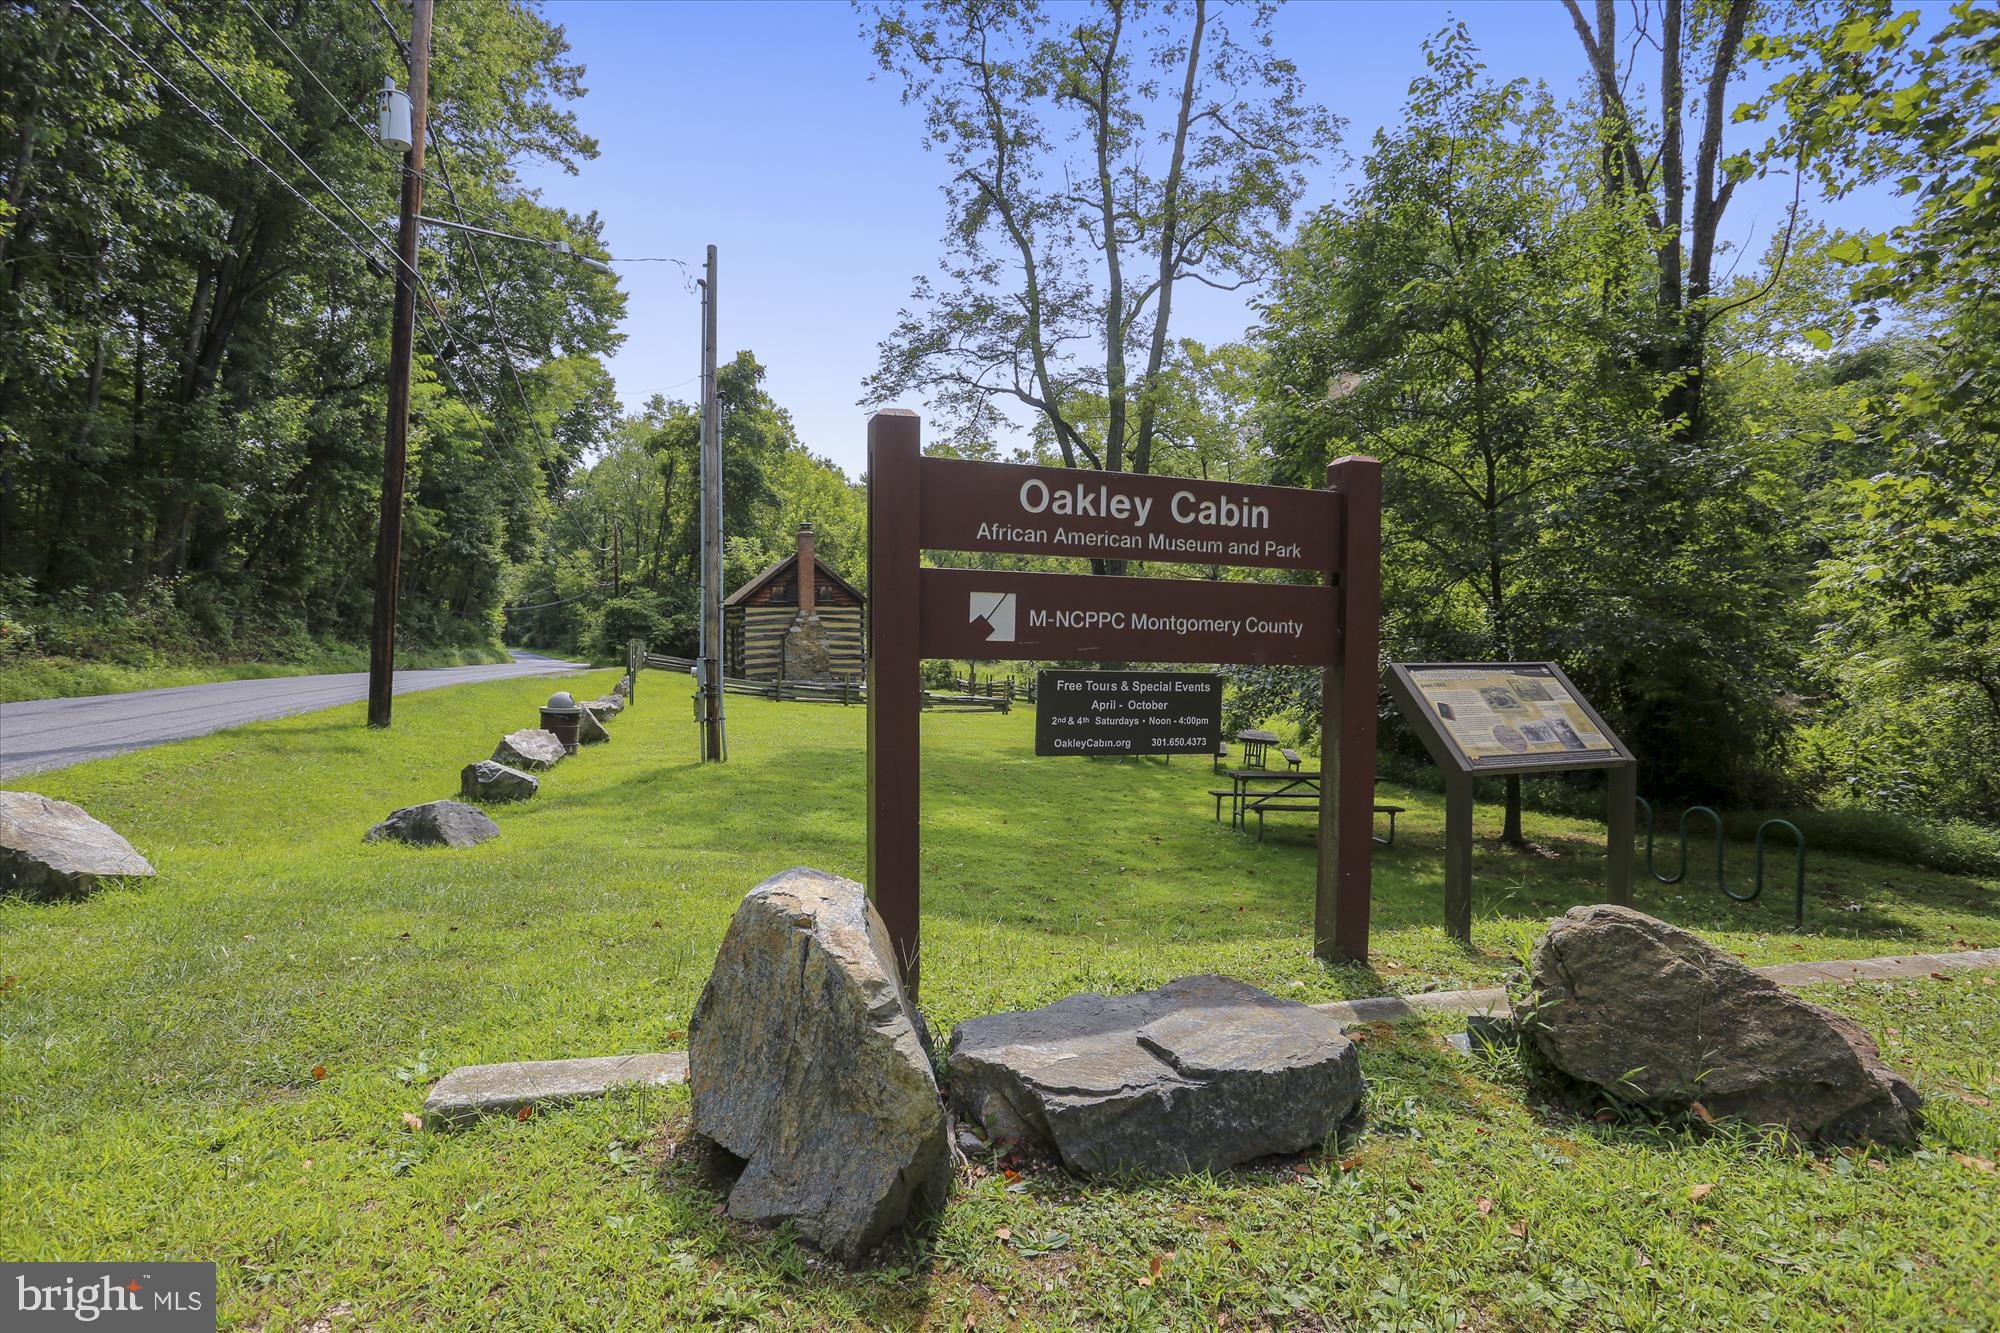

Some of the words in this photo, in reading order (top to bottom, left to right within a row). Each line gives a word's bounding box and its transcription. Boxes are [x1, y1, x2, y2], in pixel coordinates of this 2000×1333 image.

[1020, 479, 1153, 527] Oakley
[1171, 490, 1269, 529] Cabin
[976, 522, 1047, 543] African
[1053, 527, 1142, 549] American
[1148, 533, 1222, 553] Museum
[1228, 541, 1259, 556] and
[1265, 541, 1302, 558] Park
[1029, 609, 1125, 629] M-NCPPC
[1131, 613, 1241, 636] Montgomery
[1245, 616, 1304, 638] County
[1057, 680, 1082, 691] Free
[1086, 680, 1117, 692] Tours
[1121, 681, 1129, 692] &
[1132, 681, 1172, 694] Special
[1175, 682, 1211, 693] Events
[1091, 700, 1116, 712] April
[1128, 700, 1168, 710] October
[1052, 717, 1066, 725] 2nd
[1067, 717, 1075, 725] &
[1077, 717, 1089, 725] 4th
[1095, 717, 1139, 727] Saturdays
[1149, 717, 1171, 725] Noon
[1178, 717, 1209, 727] 4:00pm
[1054, 738, 1131, 749] OakleyCabin.org
[1151, 737, 1207, 747] 301.650.4373
